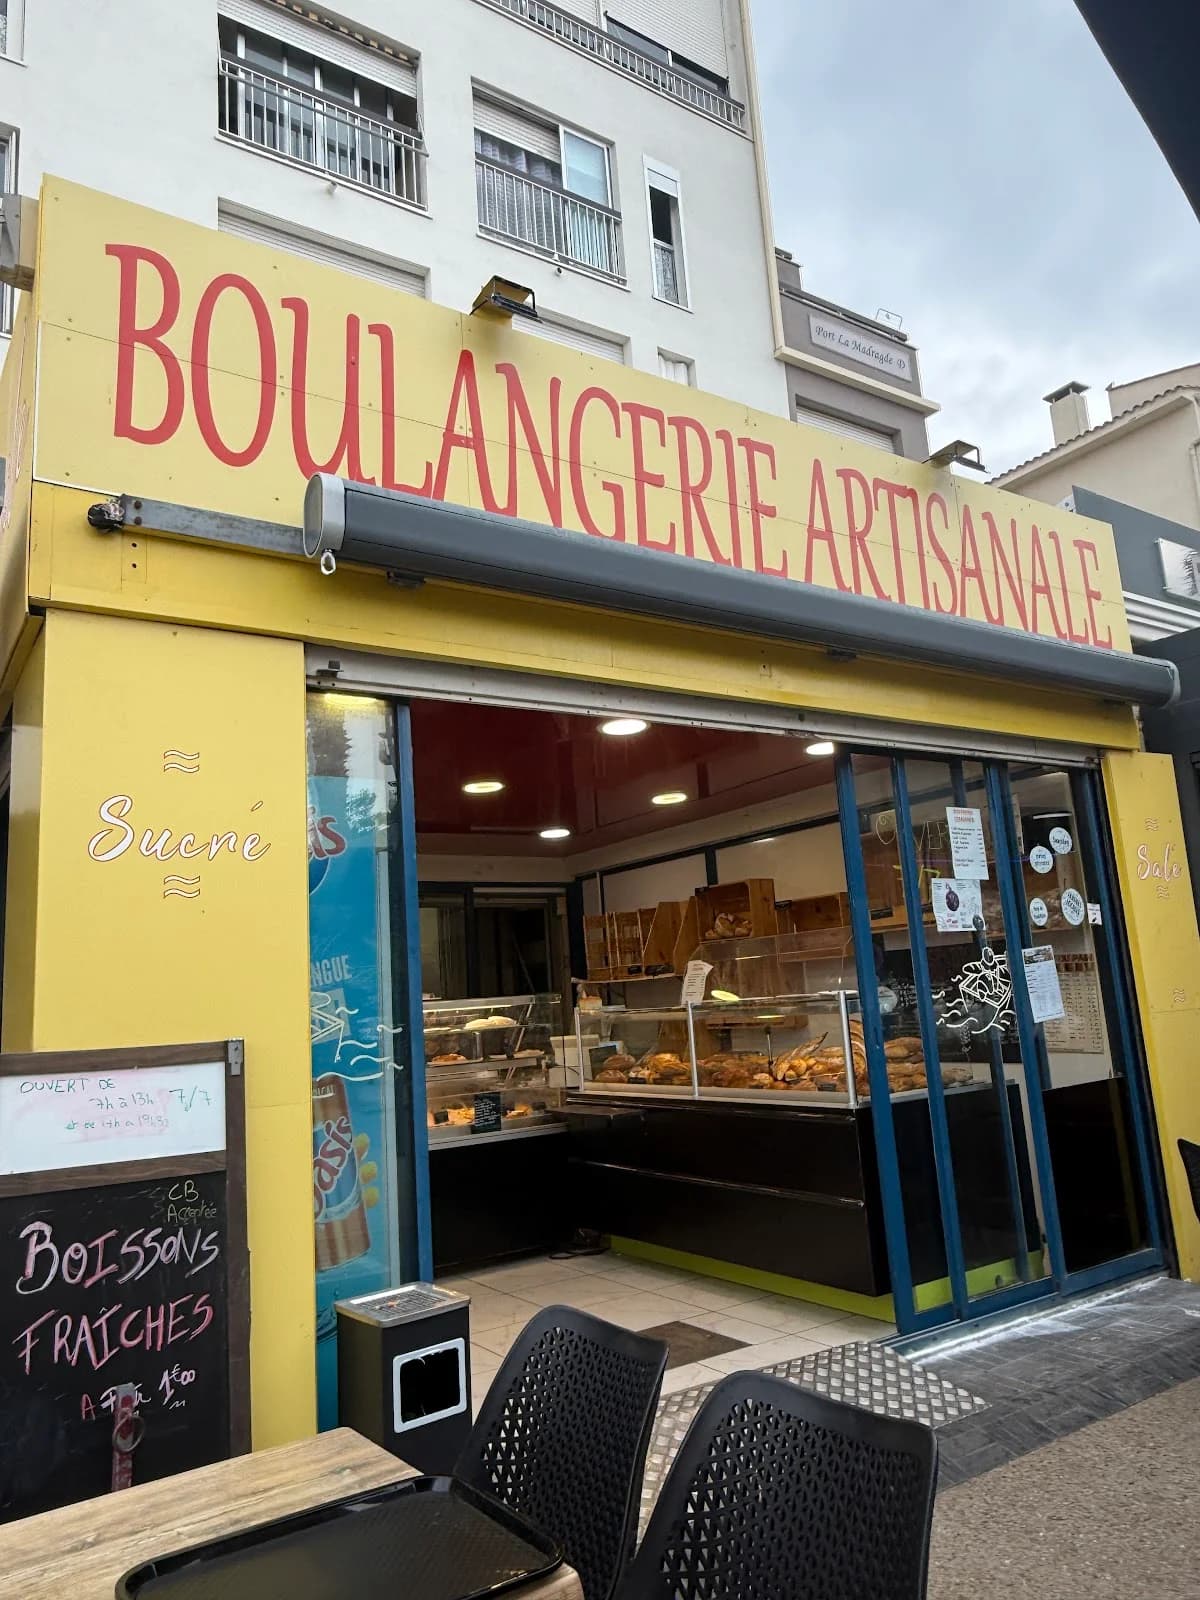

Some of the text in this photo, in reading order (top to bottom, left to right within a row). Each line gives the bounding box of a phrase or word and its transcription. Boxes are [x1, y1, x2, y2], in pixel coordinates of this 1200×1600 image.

[815, 325, 836, 341] Port
[838, 334, 850, 348] La
[105, 244, 1113, 650] BOULANGERIE ARTISANALE
[88, 795, 272, 862] Sucré
[310, 954, 353, 988] NGUE
[20, 1078, 117, 1094] OUVERT DE
[169, 1085, 213, 1113] 7/7
[168, 1180, 199, 1201] CB
[15, 1221, 220, 1295] BOISSONS
